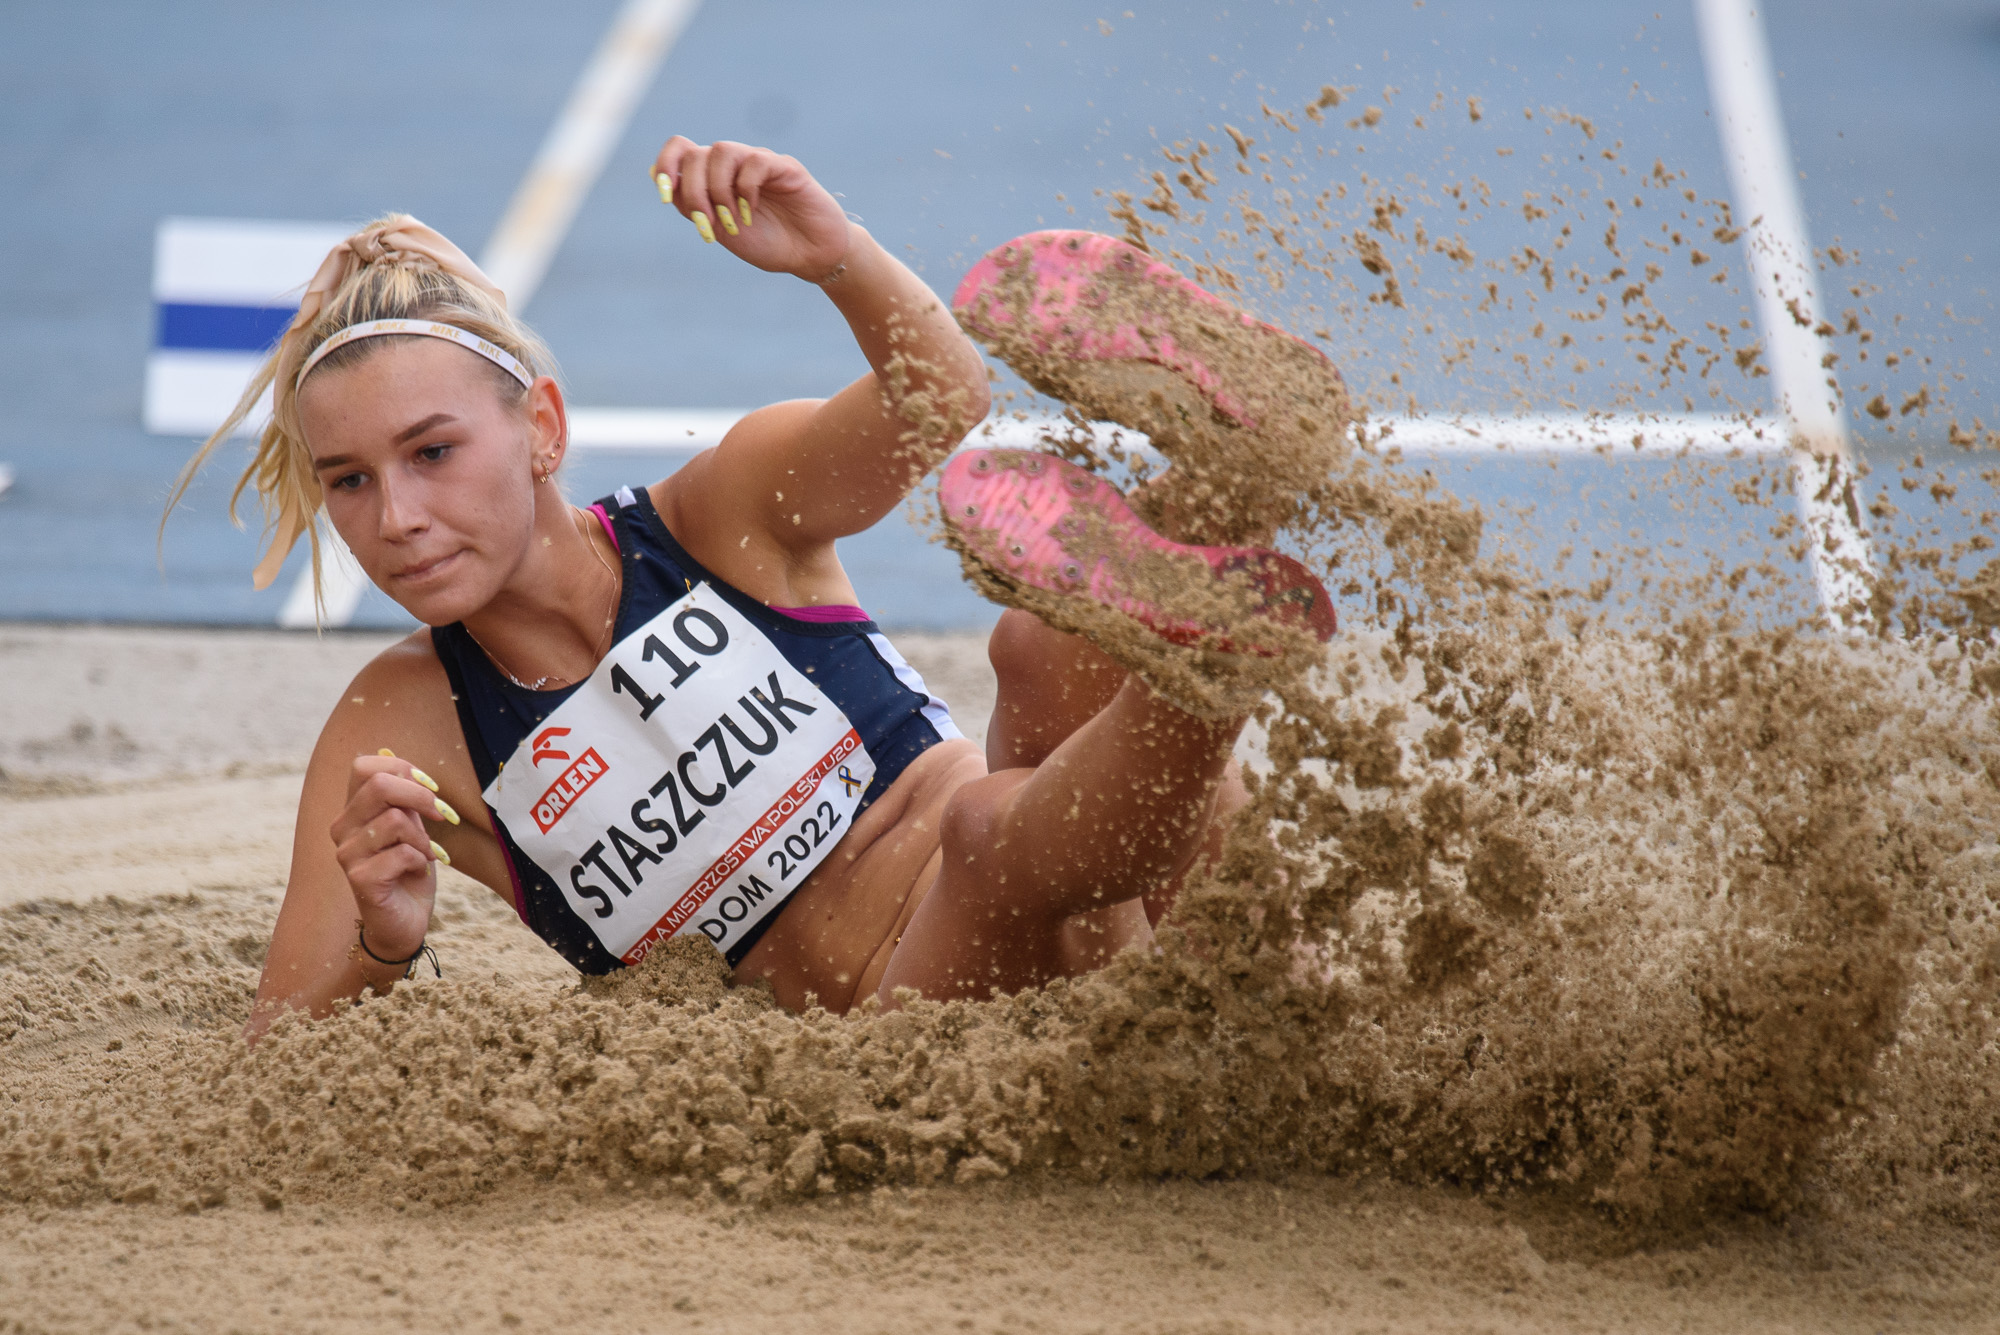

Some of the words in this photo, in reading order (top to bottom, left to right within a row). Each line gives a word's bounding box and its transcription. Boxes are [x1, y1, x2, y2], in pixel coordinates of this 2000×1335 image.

[373, 321, 406, 332] NIKE
[430, 324, 462, 340] NIKE
[477, 340, 502, 361] NIKE
[610, 607, 730, 722] 110
[537, 754, 602, 825] ORLEN
[570, 671, 818, 918] STASZCZUK
[666, 826, 771, 929] MISTRZOSTWA
[766, 768, 822, 828] POLSKI
[822, 737, 855, 771] U20
[767, 801, 842, 881] 2022
